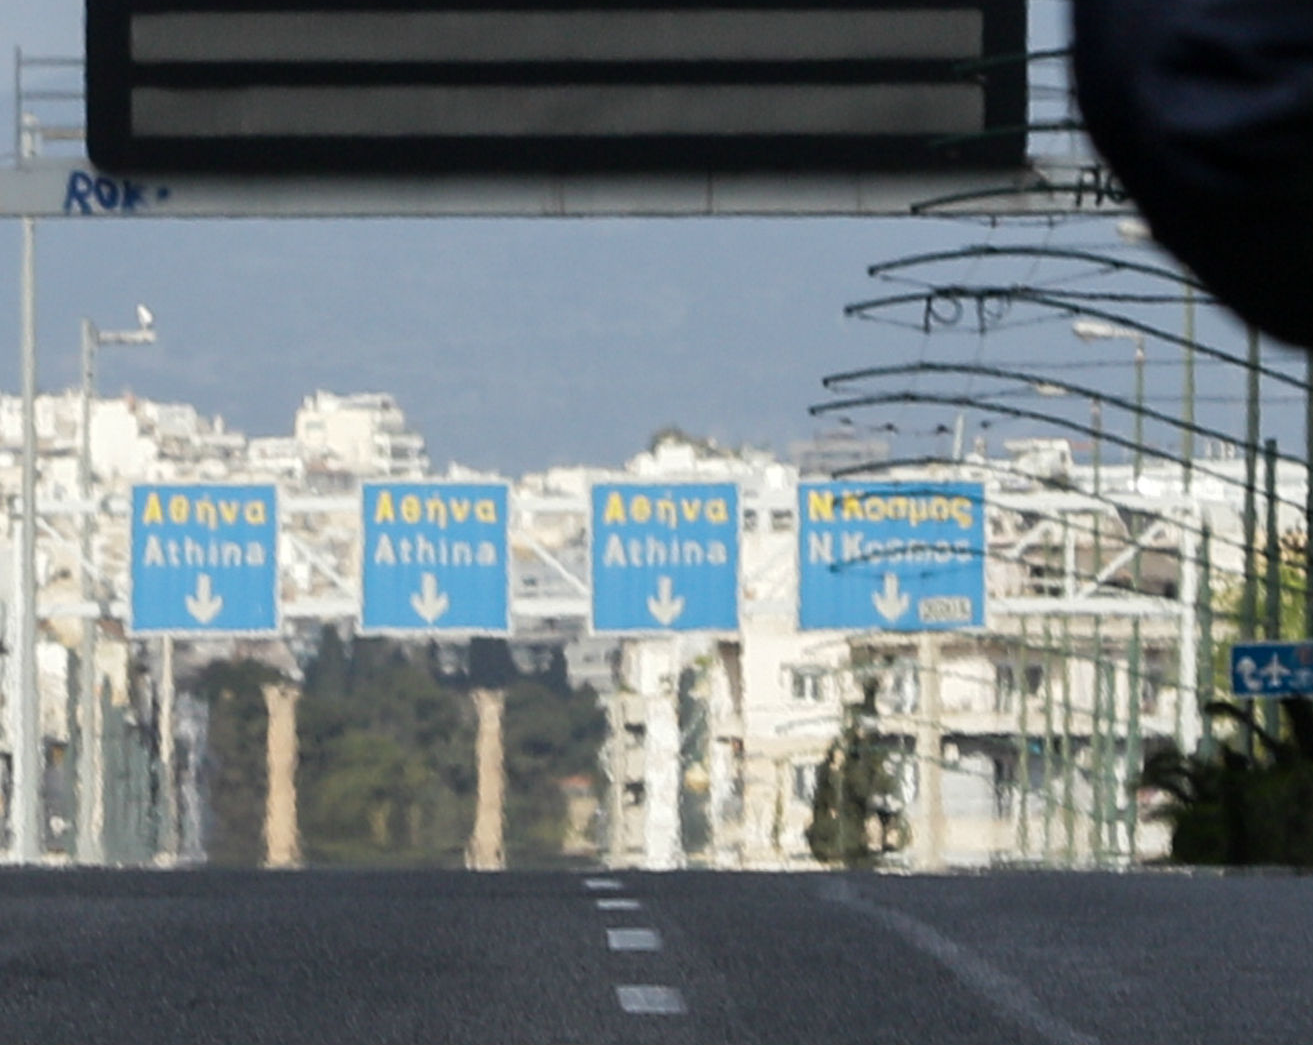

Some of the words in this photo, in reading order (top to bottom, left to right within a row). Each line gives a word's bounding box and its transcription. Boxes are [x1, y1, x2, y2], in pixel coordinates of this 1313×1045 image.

[143, 491, 267, 531] Αθήνα
[374, 489, 498, 530] Αθήνα
[603, 489, 730, 530] Αθήνα
[143, 534, 267, 567] Athina
[374, 532, 498, 567] Athina
[603, 532, 730, 568] Athina
